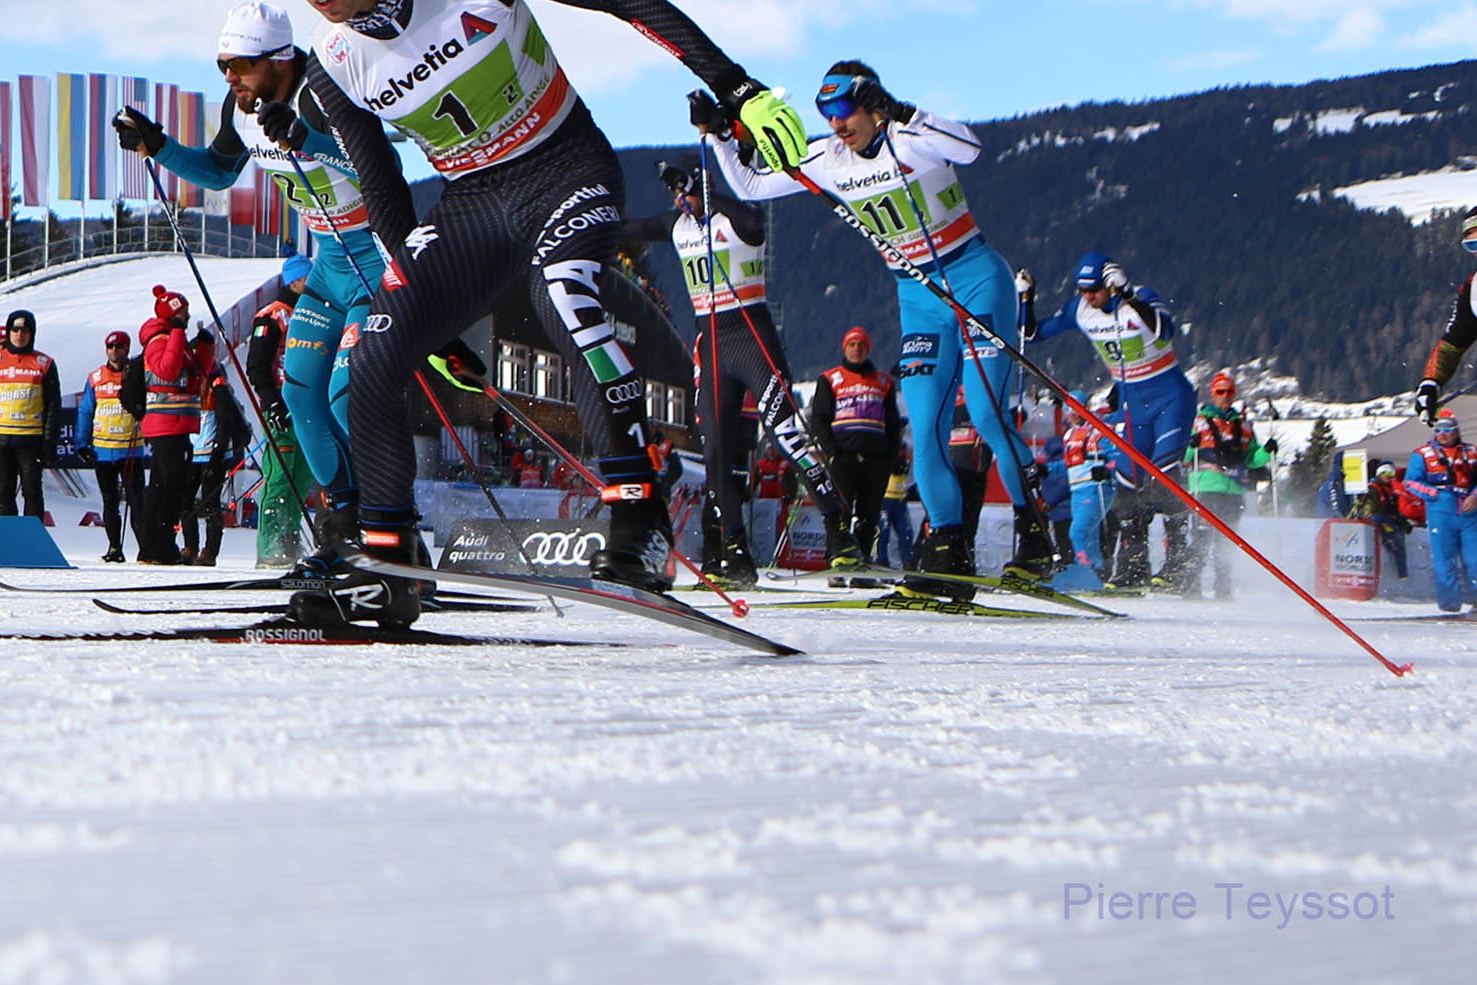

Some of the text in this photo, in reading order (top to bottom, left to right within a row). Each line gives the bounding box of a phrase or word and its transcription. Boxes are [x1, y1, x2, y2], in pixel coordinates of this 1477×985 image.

[363, 38, 464, 113] helvetia
[502, 83, 521, 105] 2
[431, 90, 479, 138] 1
[273, 173, 303, 205] 2
[321, 192, 333, 206] 2
[861, 194, 907, 236] 11
[686, 255, 710, 287] 10
[627, 422, 645, 448] 1
[453, 534, 488, 547] Audi
[449, 549, 506, 565] quattro
[866, 599, 975, 616] FISCHER
[244, 628, 326, 642] ROSSIGNOL
